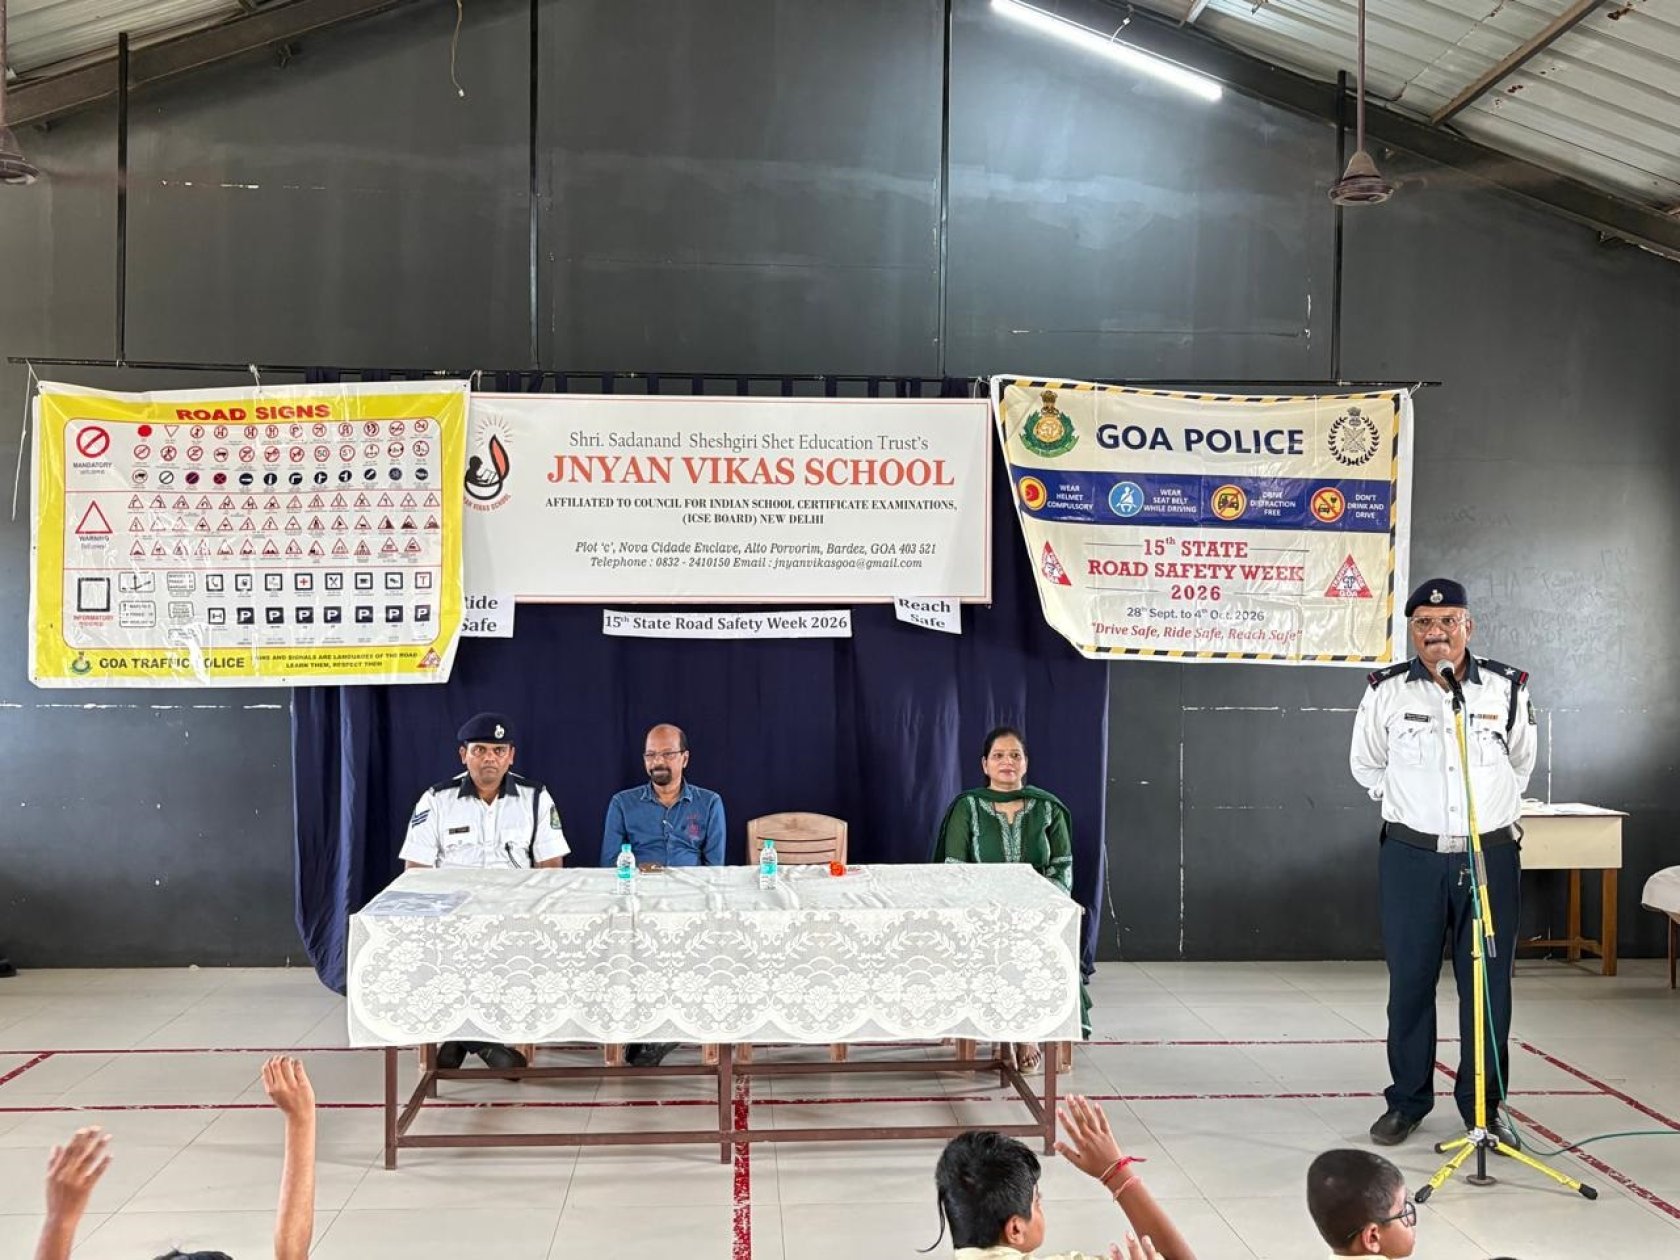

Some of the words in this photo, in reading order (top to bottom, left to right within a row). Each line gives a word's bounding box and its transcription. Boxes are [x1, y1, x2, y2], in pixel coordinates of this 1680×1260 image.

[176, 408, 246, 421] ROAD
[255, 404, 331, 420] SIGNS
[569, 431, 604, 447] Shri.
[608, 432, 681, 448] Sadanand
[689, 432, 757, 453] Sheshgiri
[761, 434, 794, 450] Shet
[799, 434, 873, 451] Education
[877, 435, 929, 451] Trust's
[1096, 424, 1173, 451] GOA
[1185, 428, 1304, 455] POLICE
[547, 455, 672, 484] JNYAN
[682, 456, 795, 486] VIKAS
[804, 458, 955, 487] SCHOOL
[1056, 493, 1083, 501] HELMET
[1153, 496, 1169, 504] SEAT
[1171, 497, 1188, 505] BELT
[1262, 491, 1283, 499] DRIVE
[545, 498, 614, 508] AFFILIATED
[617, 498, 631, 508] TO
[634, 498, 682, 509] COUNCIL
[684, 499, 706, 509] FOR
[709, 499, 750, 509] INDIAN
[751, 499, 794, 510] SCHOOL
[797, 500, 871, 510] CERTIFICATE
[872, 499, 957, 511] EXAMINATIONS,
[1047, 501, 1093, 511] COMPULSORY
[1143, 504, 1165, 512] WHILE
[1167, 505, 1197, 513] DRIVING
[1347, 502, 1368, 510] DRINK
[1263, 508, 1281, 516] FREE
[1355, 511, 1375, 519] DRIVE
[682, 513, 711, 525] (ICSE
[714, 514, 758, 525] BOARD)
[760, 514, 785, 524] NEW
[789, 514, 824, 524] DELHI
[619, 542, 648, 553] Nova
[651, 541, 691, 554] Cidade
[694, 541, 741, 555] Enclave,
[744, 542, 767, 554] Alto
[770, 542, 823, 556] Porvorim,
[827, 543, 867, 556] Bardez,
[871, 543, 896, 555] GOA
[899, 544, 917, 554] 403
[919, 543, 936, 554] 521
[1144, 537, 1176, 556] 15th
[1181, 541, 1248, 558] STATE
[590, 556, 646, 569] Telephone
[656, 557, 680, 567] 0832
[689, 557, 731, 568] 2410150
[733, 557, 767, 568] Email
[773, 557, 922, 570] jnyanvikasgoa@gmail.com
[1088, 560, 1148, 577] ROAD
[1154, 562, 1237, 580] SAFETY
[1239, 564, 1304, 581] WEEK
[1171, 585, 1221, 601] 2026
[899, 598, 950, 613] Reach
[239, 611, 251, 621] P
[269, 611, 281, 621] P
[299, 610, 310, 620] P
[327, 609, 338, 619] P
[359, 609, 369, 619] P
[388, 609, 399, 618] P
[417, 608, 428, 617] P
[1149, 608, 1178, 621] Sept.
[1180, 608, 1192, 619] to
[1235, 609, 1265, 621] 2026
[604, 616, 630, 628] 15th
[633, 617, 671, 629] State
[675, 618, 713, 630] Road
[717, 617, 762, 633] Safety
[766, 616, 808, 629] Week
[811, 616, 848, 629] 2026
[910, 614, 945, 628] Safe
[1131, 623, 1160, 640] Safe,
[1163, 625, 1192, 638] Ride
[1194, 627, 1224, 642] Safe,
[1228, 629, 1265, 641] Reach
[99, 658, 127, 669] GOA
[202, 657, 245, 668] OLICE
